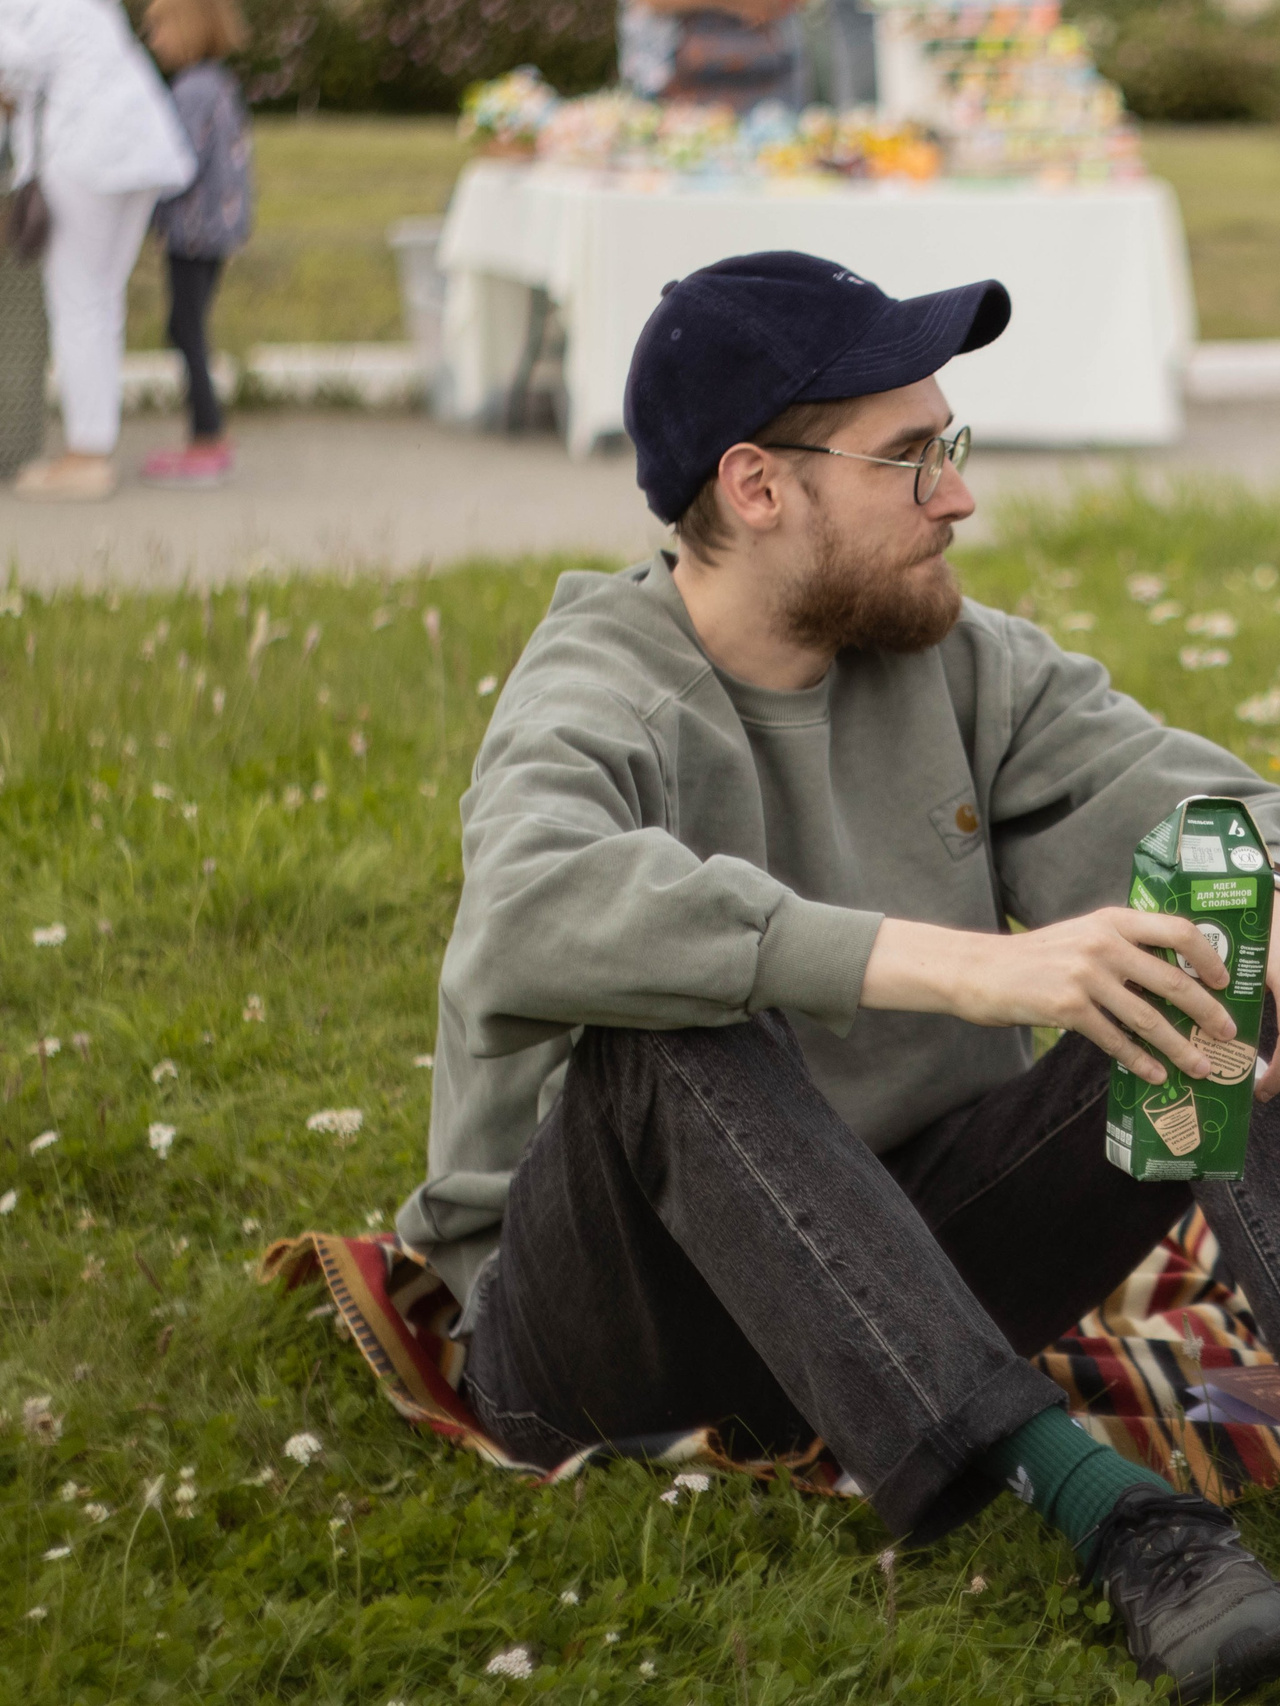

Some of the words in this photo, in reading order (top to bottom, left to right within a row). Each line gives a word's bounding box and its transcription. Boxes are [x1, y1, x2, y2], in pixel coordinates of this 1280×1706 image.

[1213, 882, 1237, 890] ИДЕИ
[1196, 892, 1214, 901] ДЛЯ
[1215, 889, 1252, 899] УЖИНОВ
[1208, 897, 1247, 907] ПОЛЬЗОЙ
